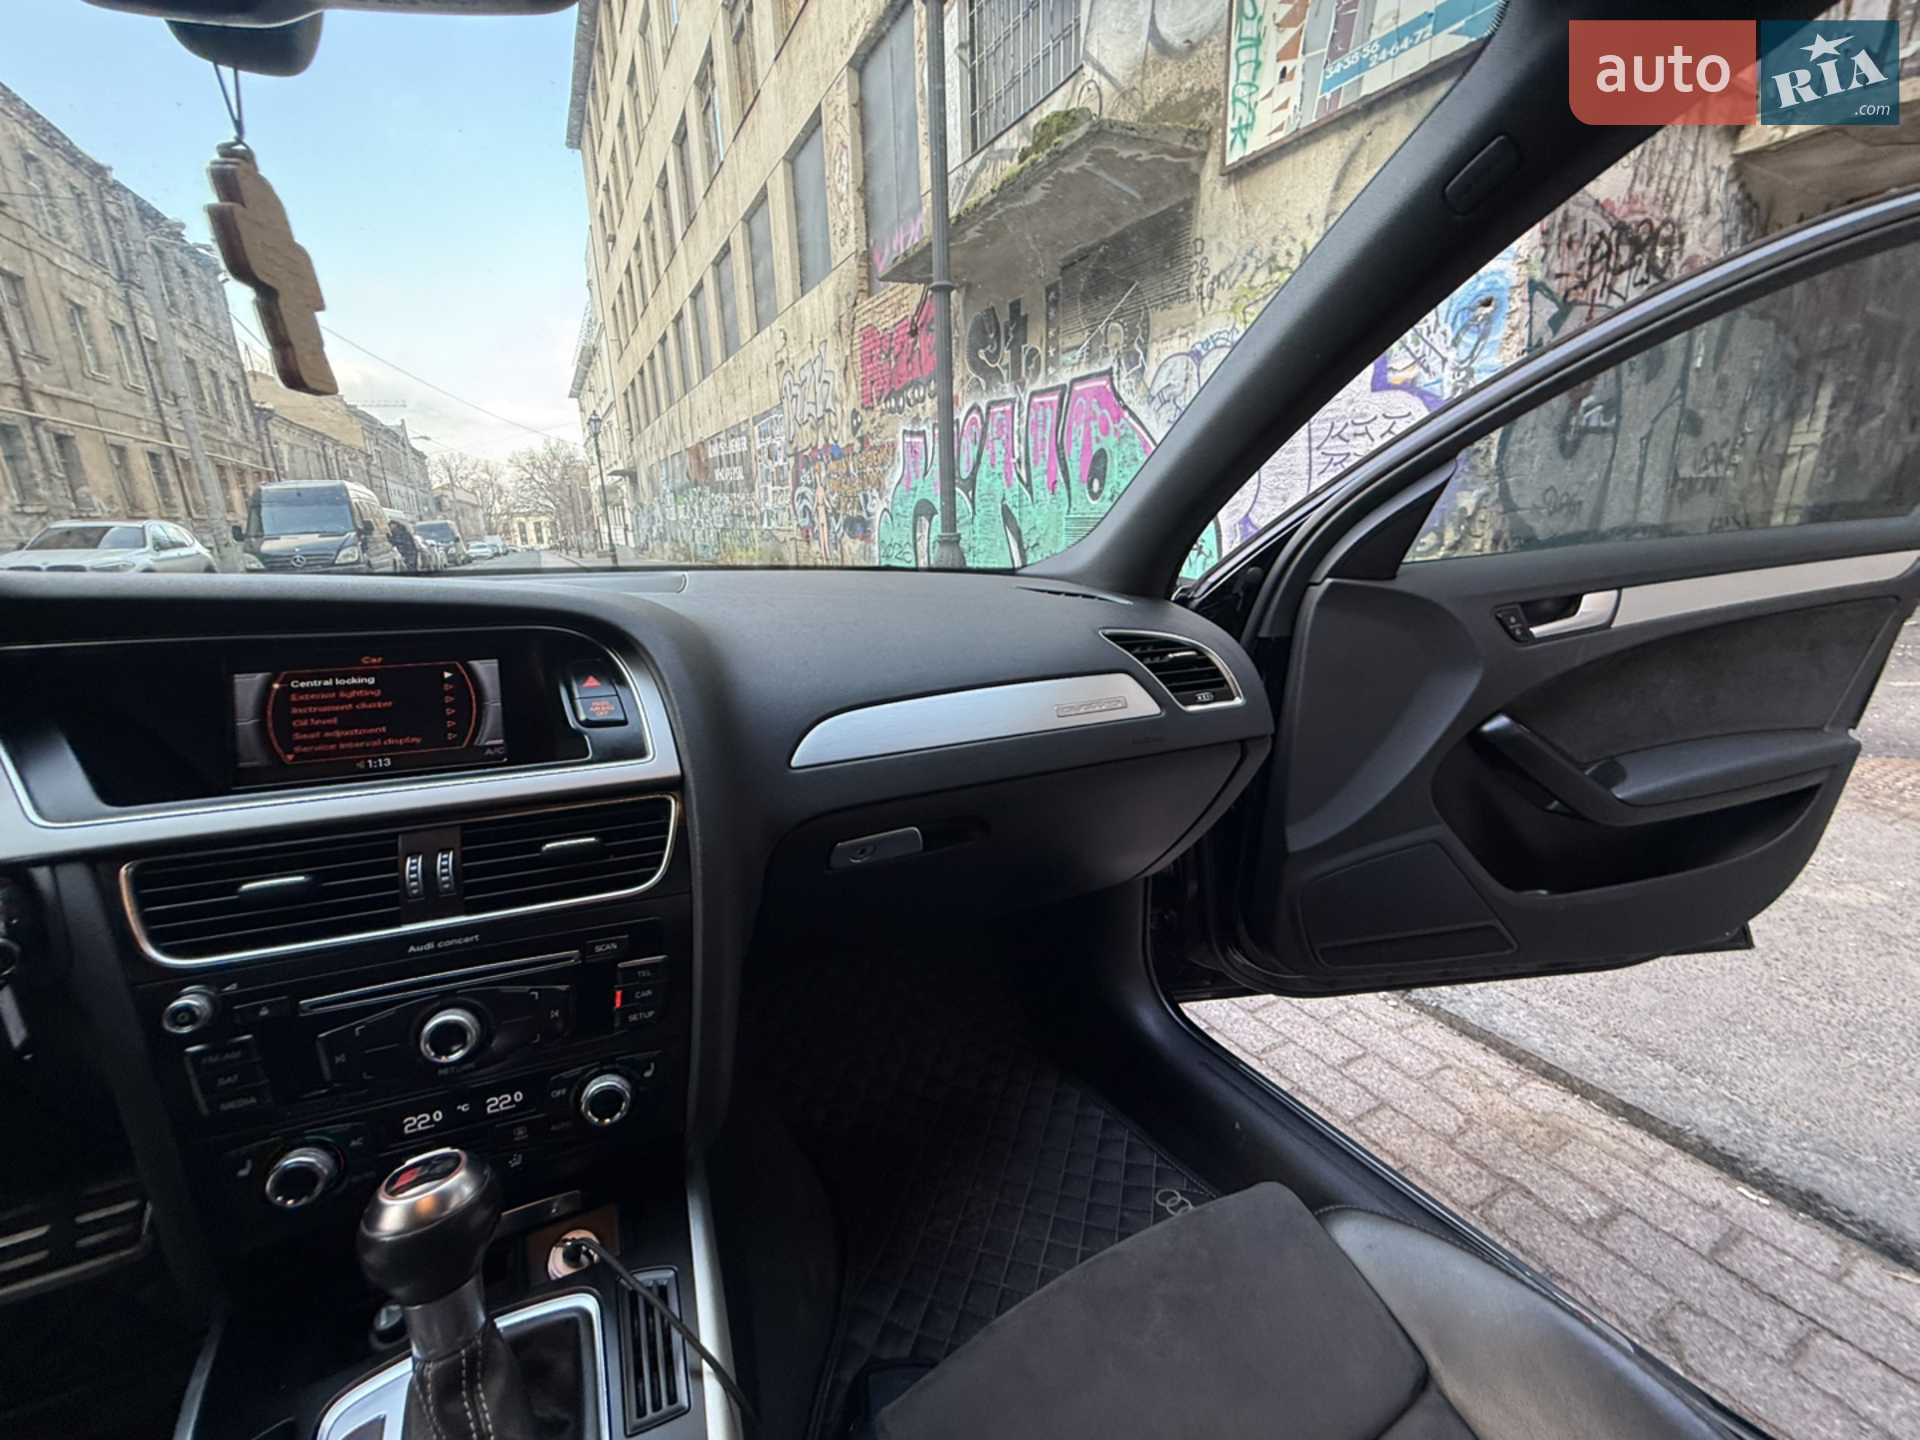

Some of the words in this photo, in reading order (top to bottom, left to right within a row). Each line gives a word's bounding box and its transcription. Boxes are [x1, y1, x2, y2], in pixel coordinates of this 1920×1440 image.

[361, 656, 383, 664] Car
[290, 677, 334, 688] Central
[335, 675, 376, 687] locking
[355, 700, 393, 709] cluster
[382, 735, 422, 746] display
[366, 757, 392, 768] 1:13
[407, 937, 435, 953] Audi
[436, 934, 480, 949] concert
[594, 942, 618, 952] SCAN
[628, 1010, 655, 1022] SETUP
